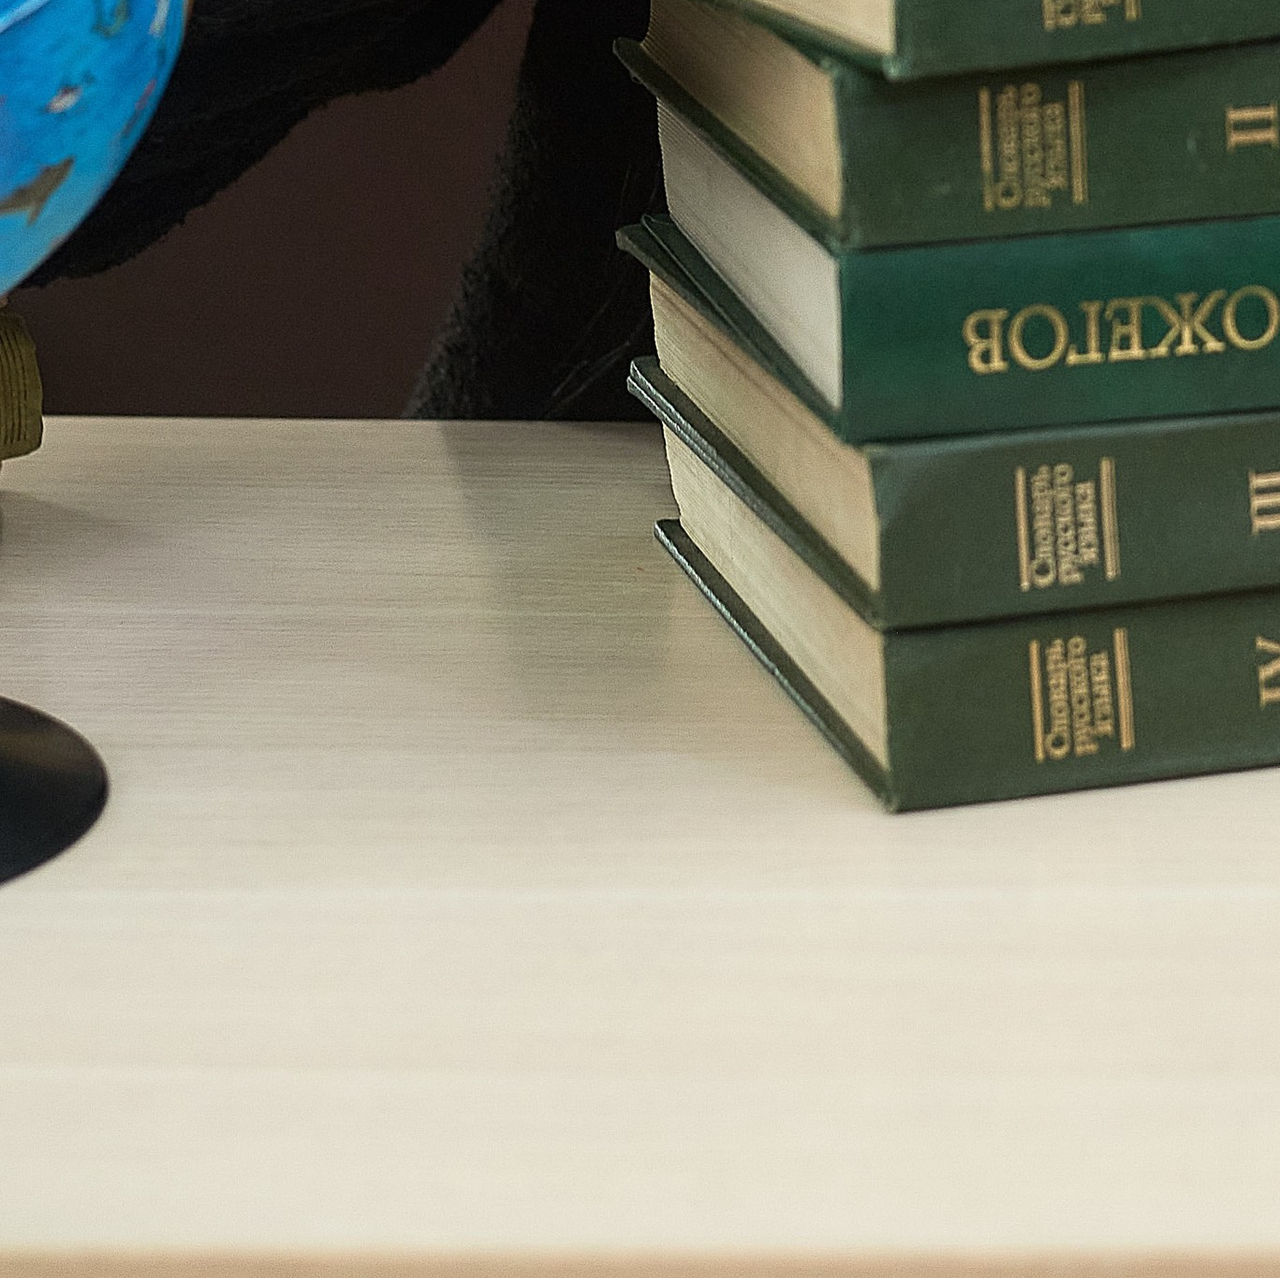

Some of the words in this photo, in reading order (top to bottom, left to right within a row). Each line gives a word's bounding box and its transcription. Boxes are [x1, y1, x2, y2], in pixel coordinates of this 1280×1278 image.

[1225, 101, 1279, 154] II
[1031, 464, 1057, 589] Словарь
[1053, 461, 1085, 587] русского
[1075, 479, 1100, 566] языка
[1045, 637, 1071, 761] Словарь
[1067, 635, 1099, 759] русского
[1090, 649, 1116, 739] языка
